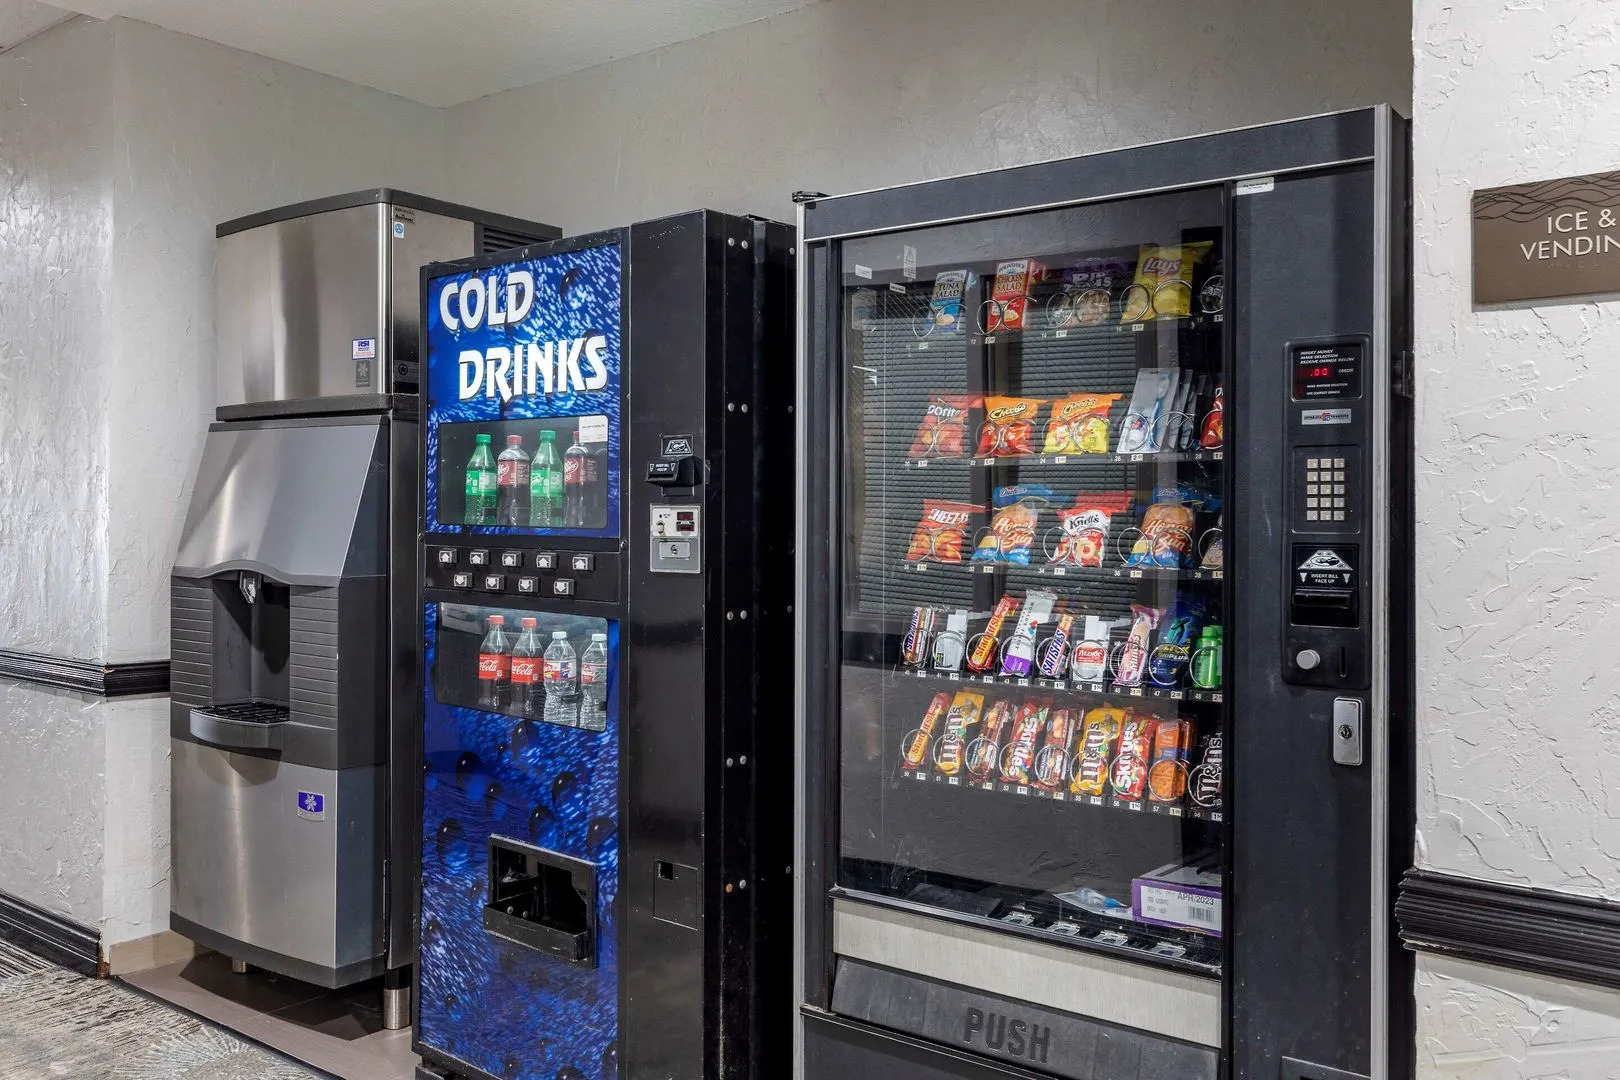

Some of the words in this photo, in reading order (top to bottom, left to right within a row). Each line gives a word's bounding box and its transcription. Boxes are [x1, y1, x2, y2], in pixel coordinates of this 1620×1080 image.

[1547, 211, 1588, 234] ICE
[1598, 209, 1616, 228] &
[935, 289, 960, 298] SALAD
[939, 282, 959, 290] TUNA
[997, 282, 1022, 291] SALAD
[439, 270, 534, 331] COLD
[458, 335, 608, 404] DRINKS
[963, 1007, 1050, 1063] PUSH
